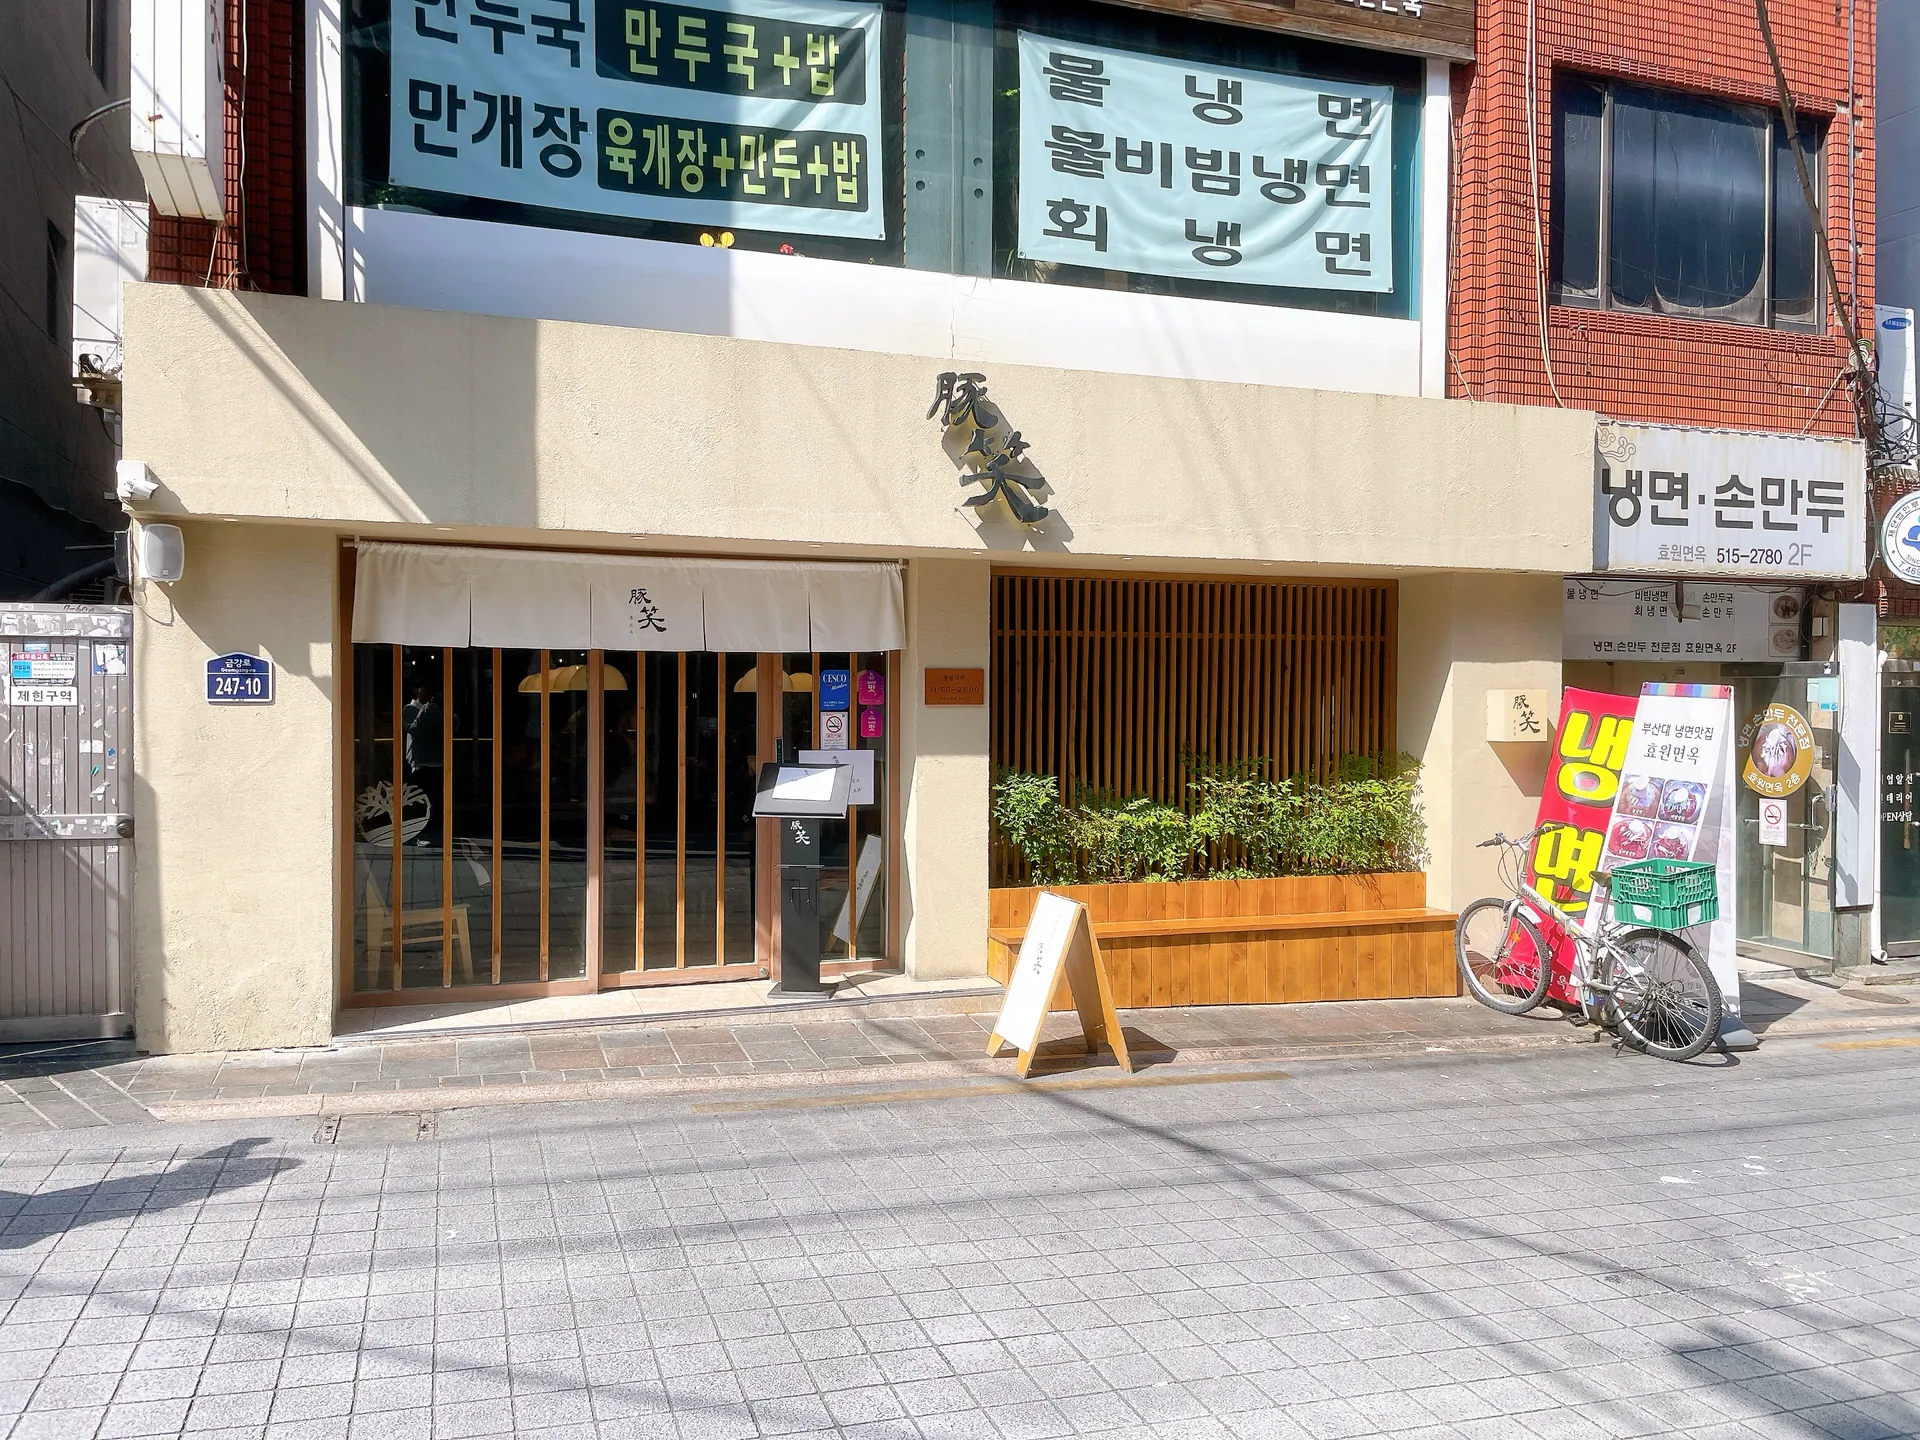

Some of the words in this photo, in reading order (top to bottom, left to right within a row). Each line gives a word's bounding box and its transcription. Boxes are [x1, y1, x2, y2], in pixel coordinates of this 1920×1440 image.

[408, 78, 588, 179] 만개장
[604, 117, 860, 204] 육개장+만두+밥
[1044, 125, 1371, 209] 물비빔냉면
[1657, 543, 1707, 563] 효원면옥
[1716, 547, 1783, 565] 515-2780
[1787, 542, 1813, 566] 2F
[1634, 590, 1669, 602] 비빔냉면
[1702, 592, 1734, 604] 손만두국
[1650, 642, 1681, 653] 전문점
[1685, 643, 1723, 654] 효원면옥
[1726, 643, 1737, 654] 2F
[225, 658, 252, 668] 금강로
[215, 677, 262, 696] 247-10
[822, 673, 847, 683] CESCO
[17, 690, 72, 702] 제한구역
[1641, 722, 1671, 737] 부산대
[1675, 724, 1715, 741] 냉면맛집
[1785, 713, 1811, 750] 전문점
[1643, 743, 1701, 766] 효원면옥
